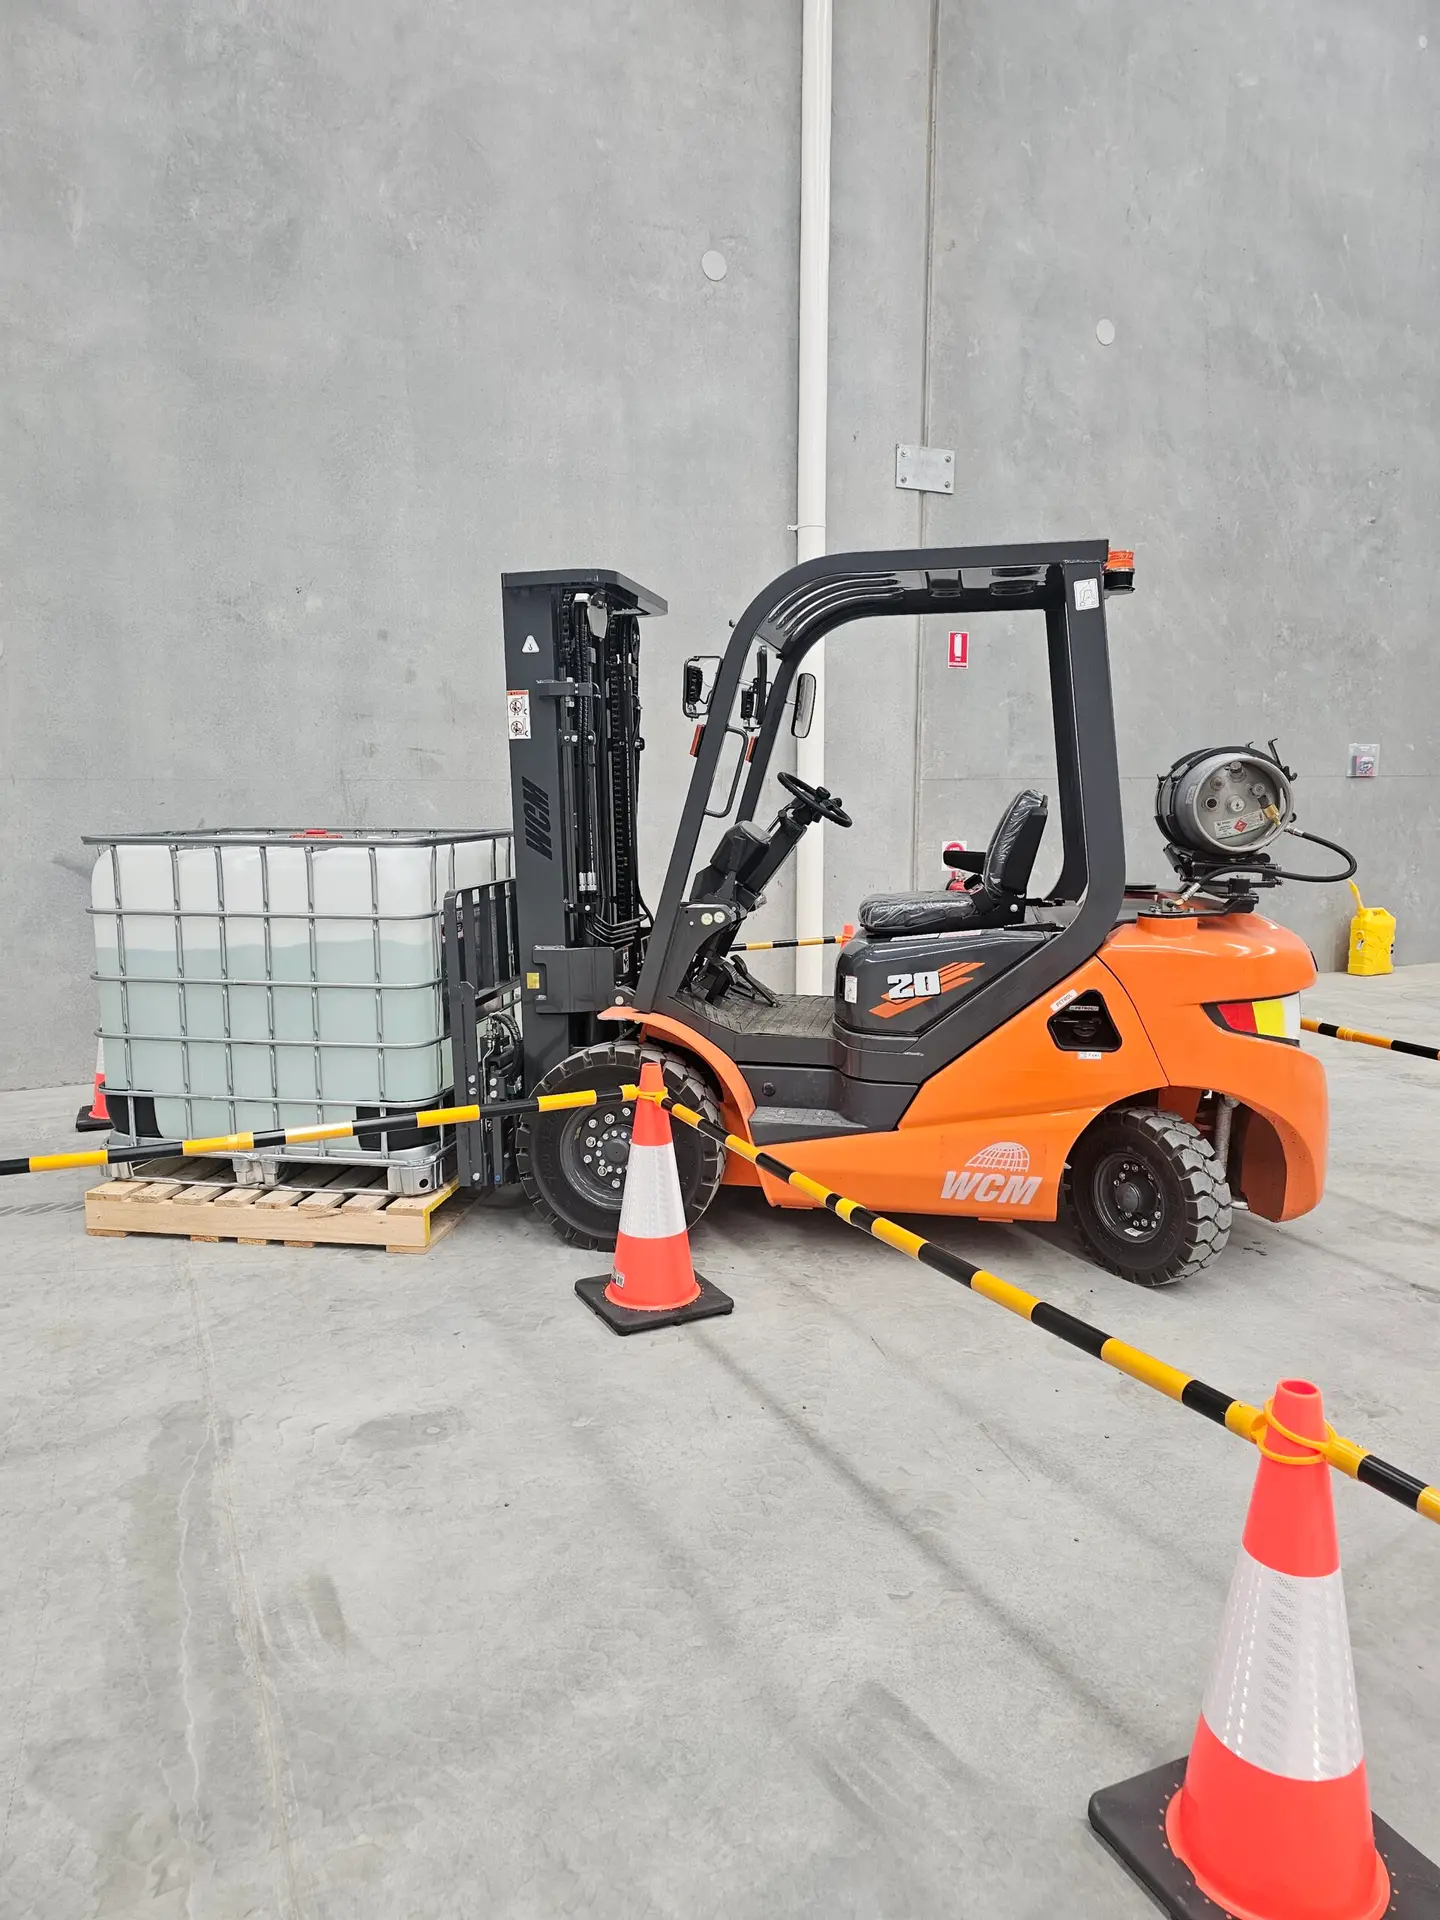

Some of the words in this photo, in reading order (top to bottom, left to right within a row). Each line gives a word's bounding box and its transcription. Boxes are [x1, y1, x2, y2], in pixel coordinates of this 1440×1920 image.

[522, 776, 552, 860] WCM
[887, 971, 941, 1000] 20
[940, 1171, 1043, 1204] WCM
